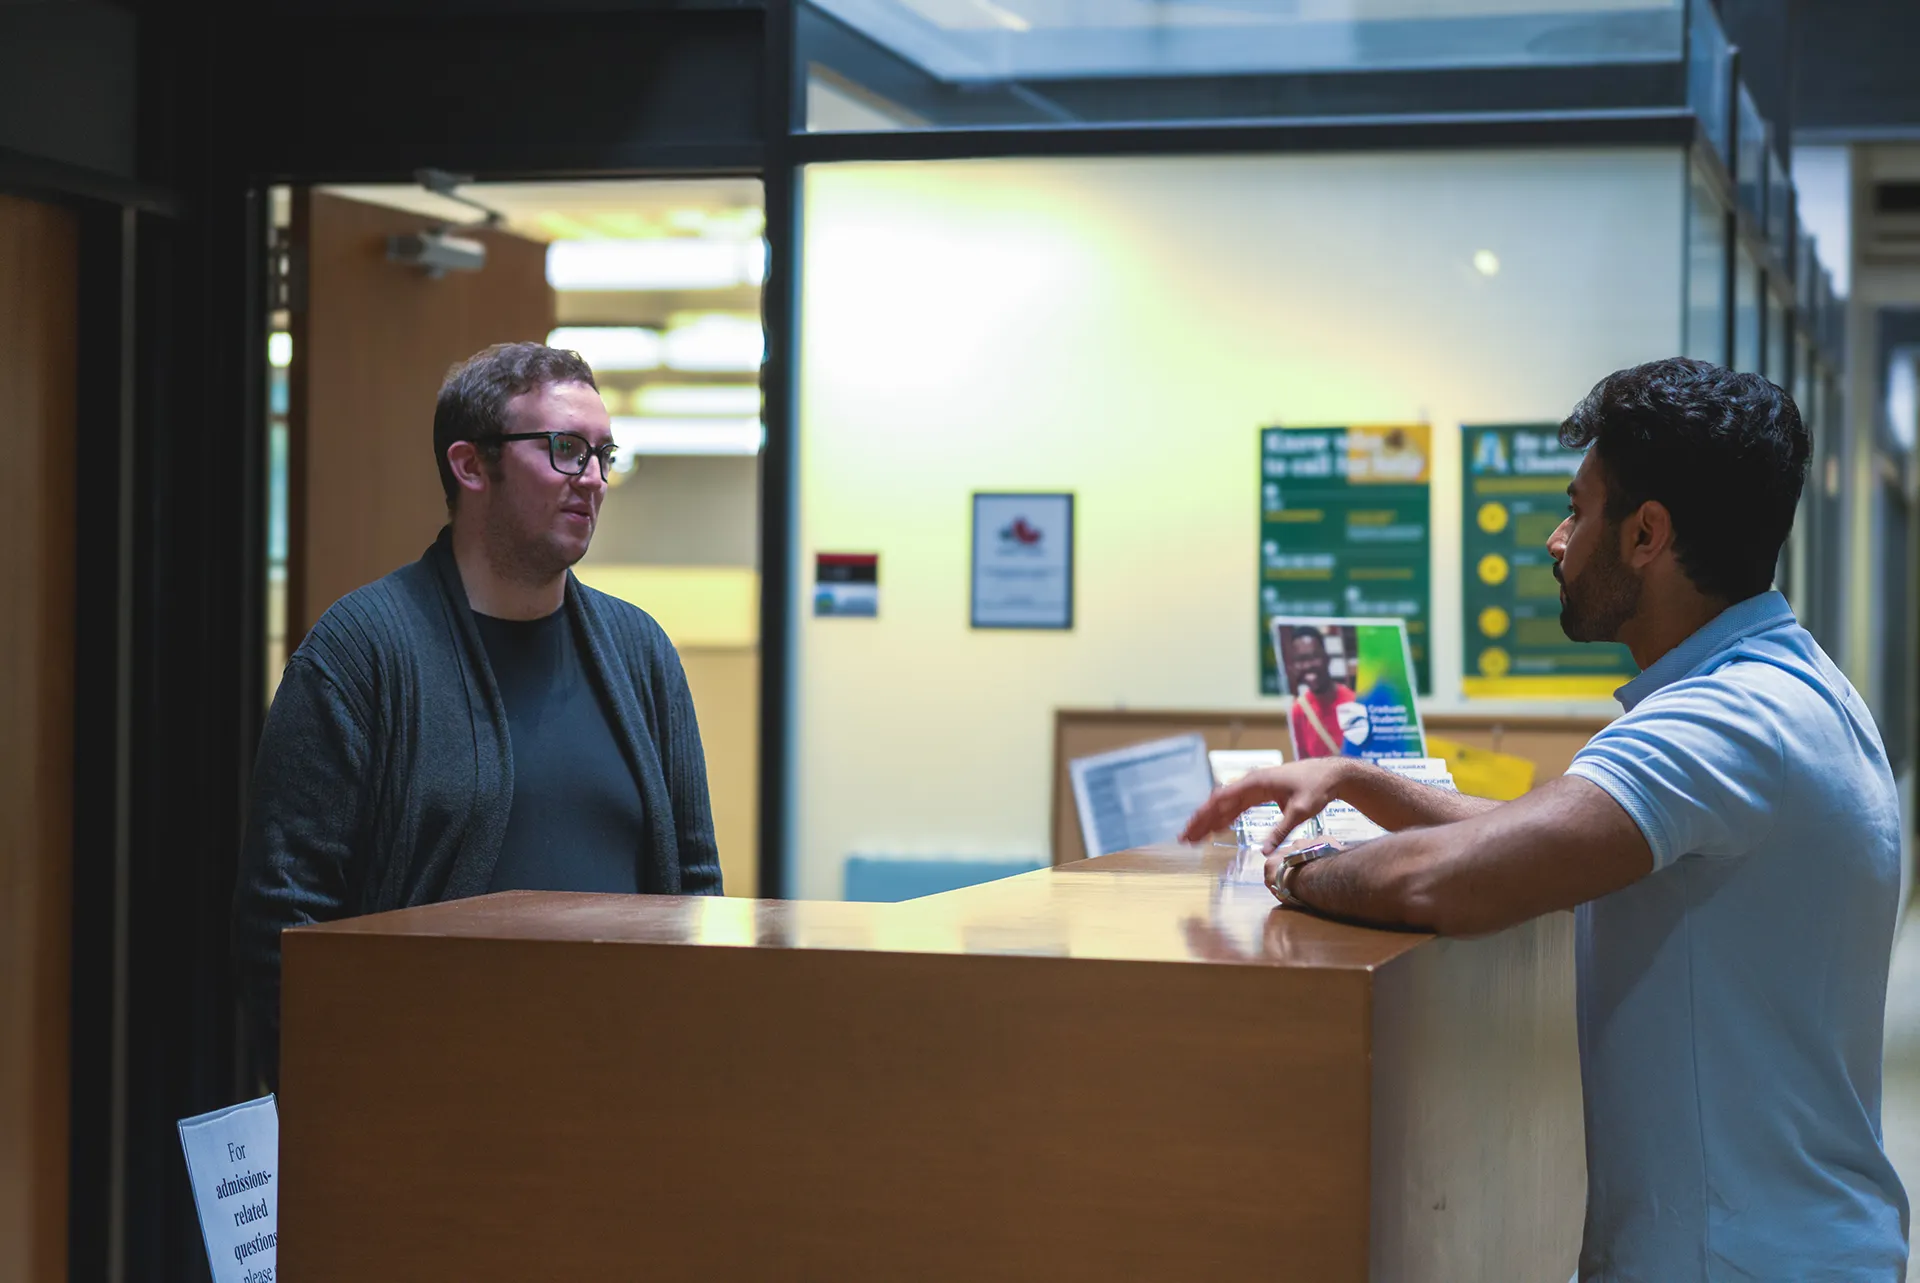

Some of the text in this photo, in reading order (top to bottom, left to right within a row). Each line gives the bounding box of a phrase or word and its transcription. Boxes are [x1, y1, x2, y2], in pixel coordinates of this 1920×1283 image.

[1368, 704, 1407, 713] Graduate
[227, 1142, 246, 1162] For
[216, 1170, 272, 1199] admissions-
[234, 1198, 269, 1227] related
[234, 1232, 278, 1266] questions
